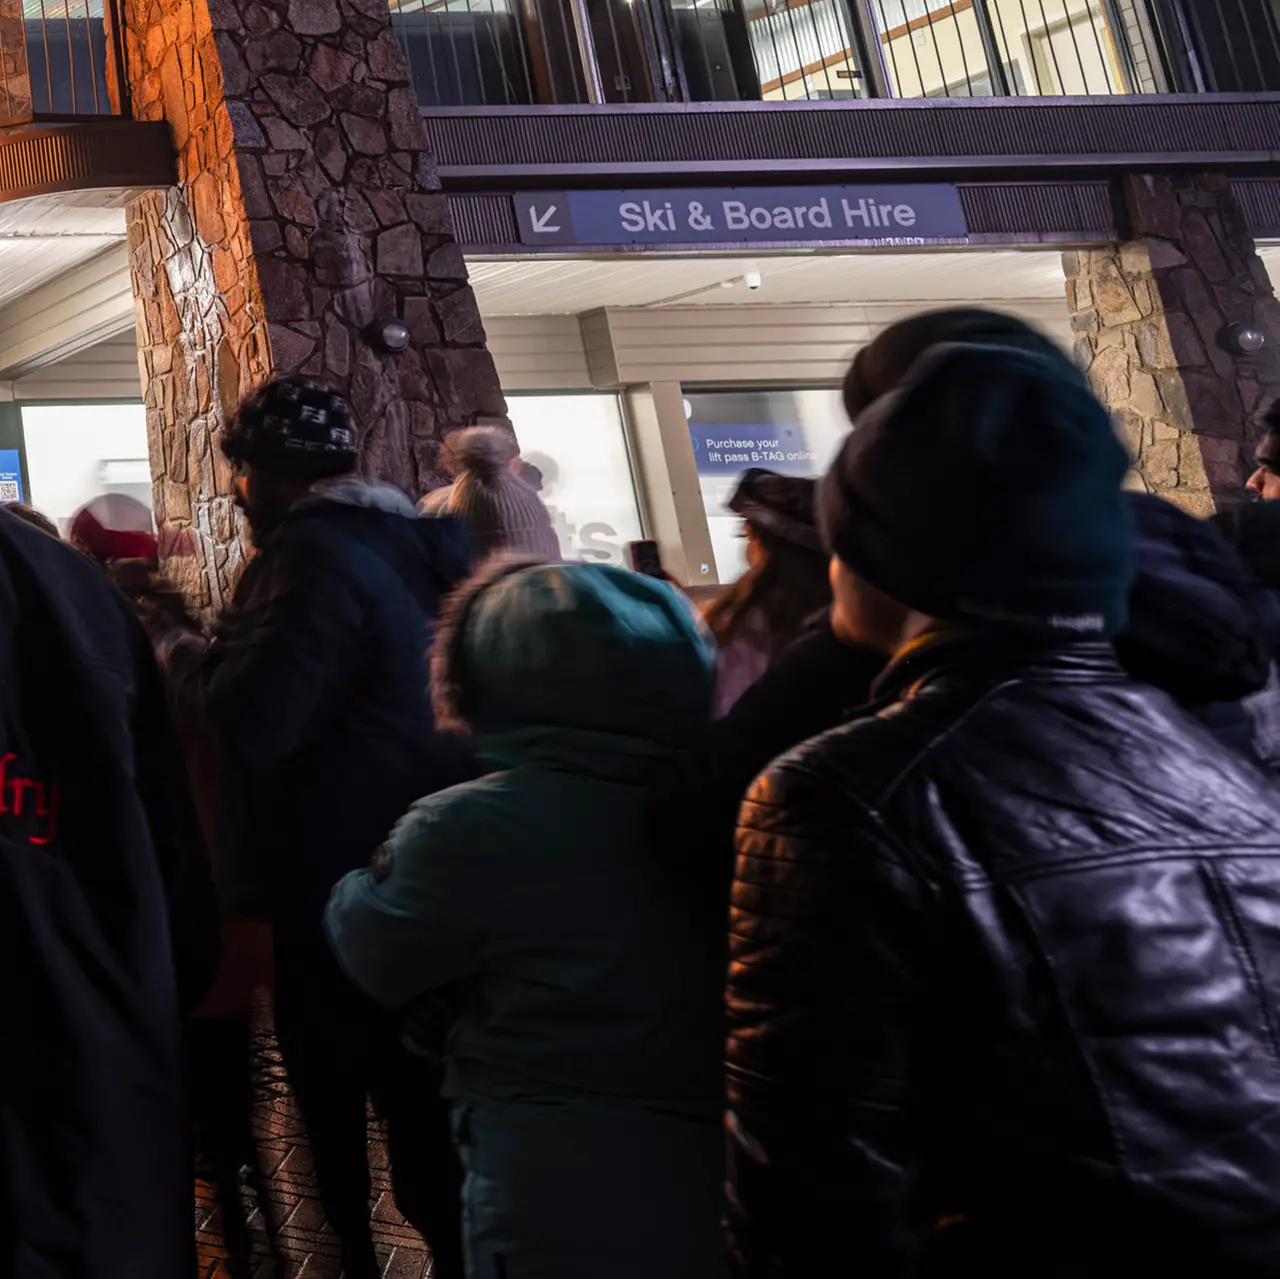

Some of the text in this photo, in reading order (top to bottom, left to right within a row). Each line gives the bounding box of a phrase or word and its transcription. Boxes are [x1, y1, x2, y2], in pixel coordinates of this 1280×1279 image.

[618, 197, 916, 232] Ski & Board Hire
[705, 438, 780, 450] Purchase your
[709, 451, 721, 463] lift
[724, 453, 749, 464] pass
[751, 451, 785, 462] B-TAG
